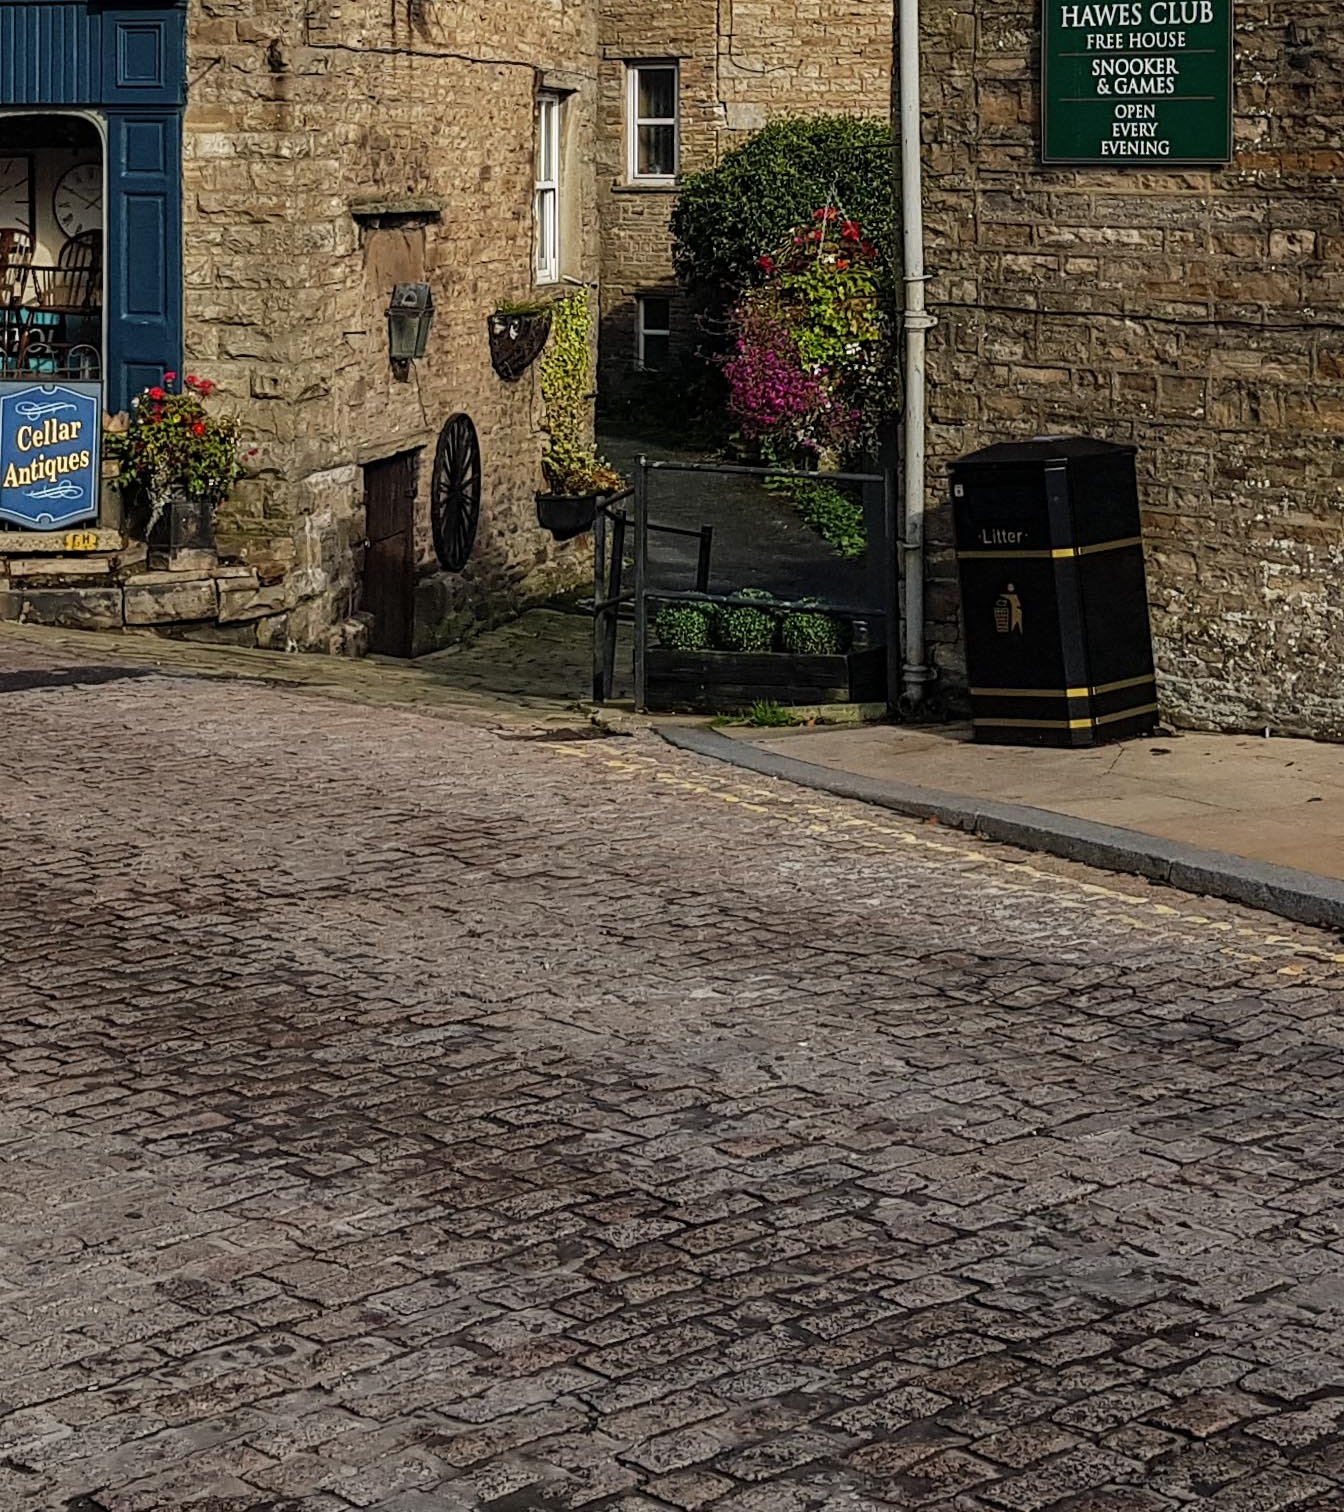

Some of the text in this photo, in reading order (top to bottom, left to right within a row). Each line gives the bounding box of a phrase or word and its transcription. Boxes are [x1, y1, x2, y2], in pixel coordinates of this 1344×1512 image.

[1061, 1, 1213, 27] HAWES CLUB
[1087, 31, 1186, 49] FREE HOUSE
[1092, 58, 1179, 76] SNOOKER
[1097, 77, 1175, 95] & GAMES
[1114, 104, 1156, 119] OPEN
[1112, 123, 1158, 138] EVERY
[1100, 141, 1170, 156] EVENING
[17, 418, 82, 451] Cellar
[3, 450, 90, 488] Antiques
[982, 528, 1023, 545] Litter
